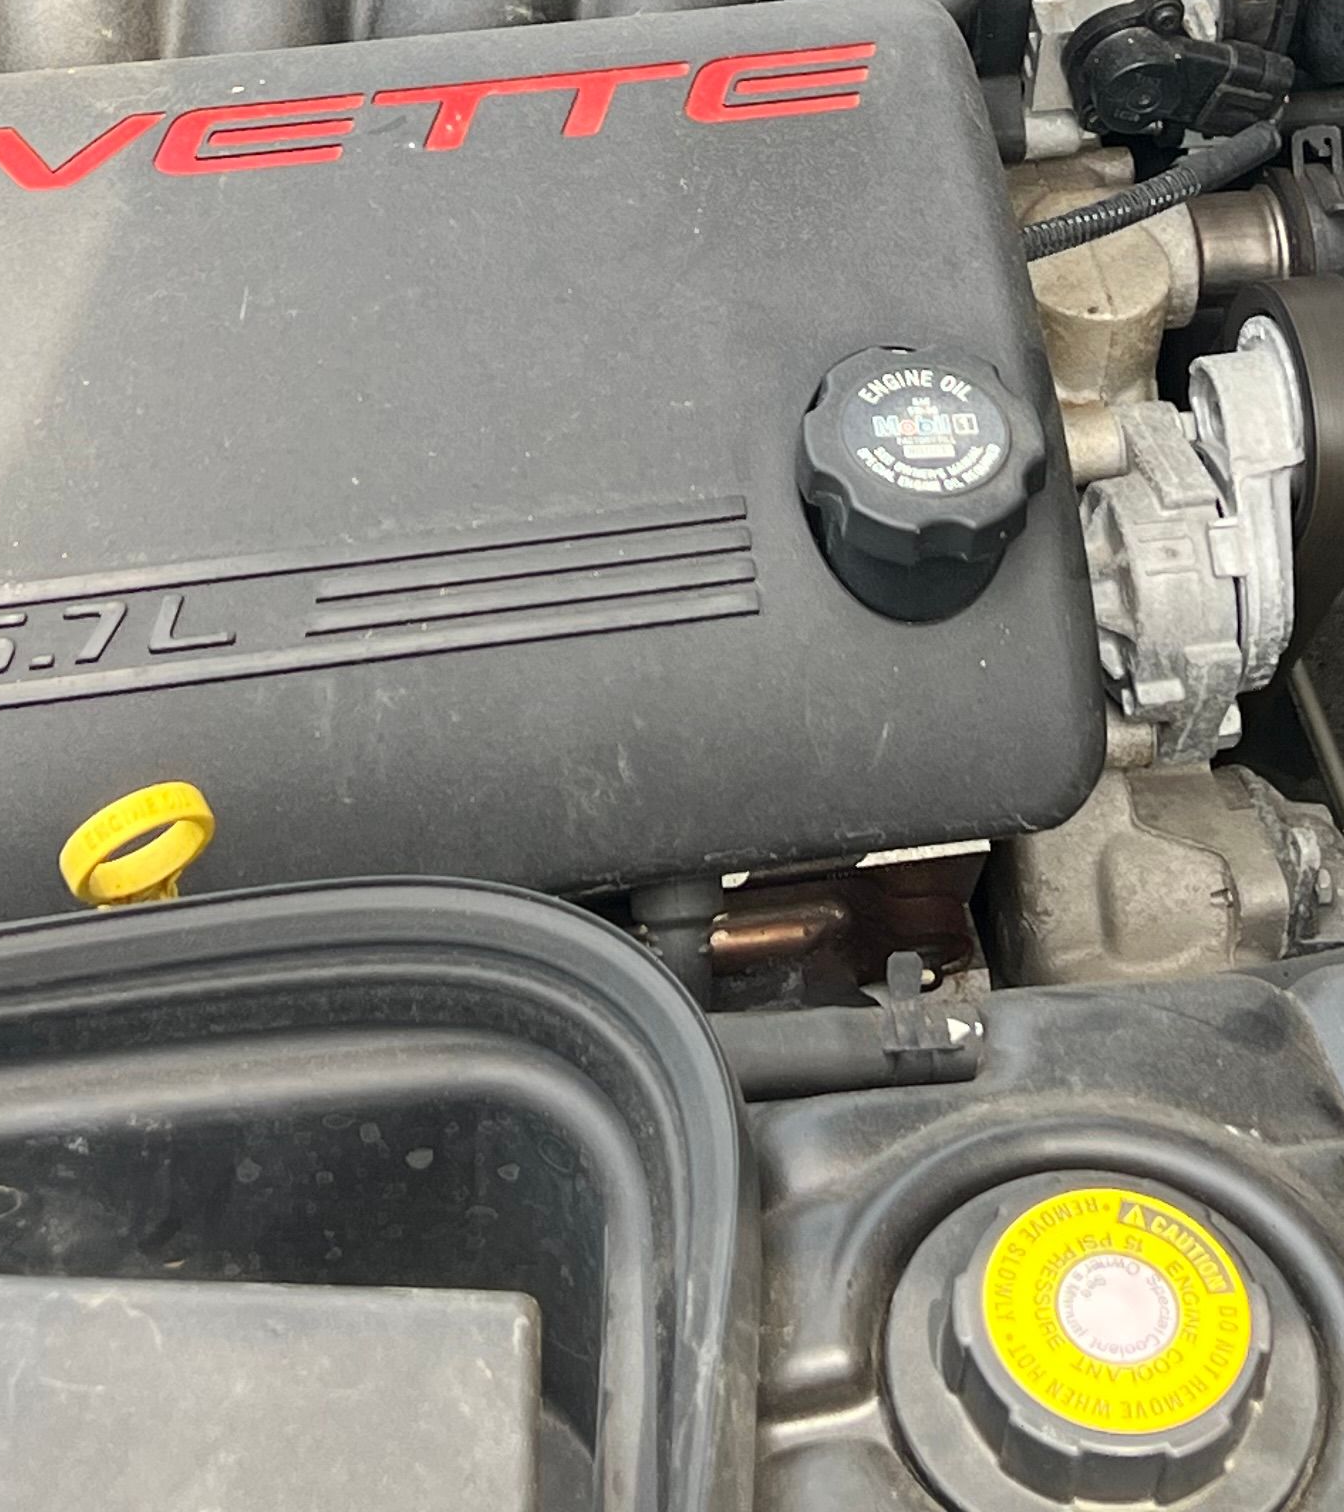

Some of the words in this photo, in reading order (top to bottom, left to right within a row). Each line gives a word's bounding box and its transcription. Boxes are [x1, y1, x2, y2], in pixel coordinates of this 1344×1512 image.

[857, 369, 934, 405] ENGINE
[940, 375, 973, 402] OIL
[871, 413, 952, 438] Mobil
[83, 796, 158, 851] ENGINE
[1018, 1197, 1099, 1243] REMOVE
[1077, 1232, 1114, 1254] PSI
[1123, 1234, 1145, 1253] 15
[1150, 1214, 1229, 1293] CAUTION
[994, 1242, 1027, 1322] SLOWLY
[1033, 1243, 1078, 1352] PRESSURE
[1163, 1259, 1201, 1345] ENGINE
[1218, 1304, 1240, 1333] DO
[1007, 1344, 1047, 1382] HOT
[1070, 1346, 1186, 1386] COOLANT
[1209, 1339, 1235, 1380] NOT
[1045, 1377, 1112, 1420] WHEN
[1119, 1378, 1210, 1420] REMOVE
